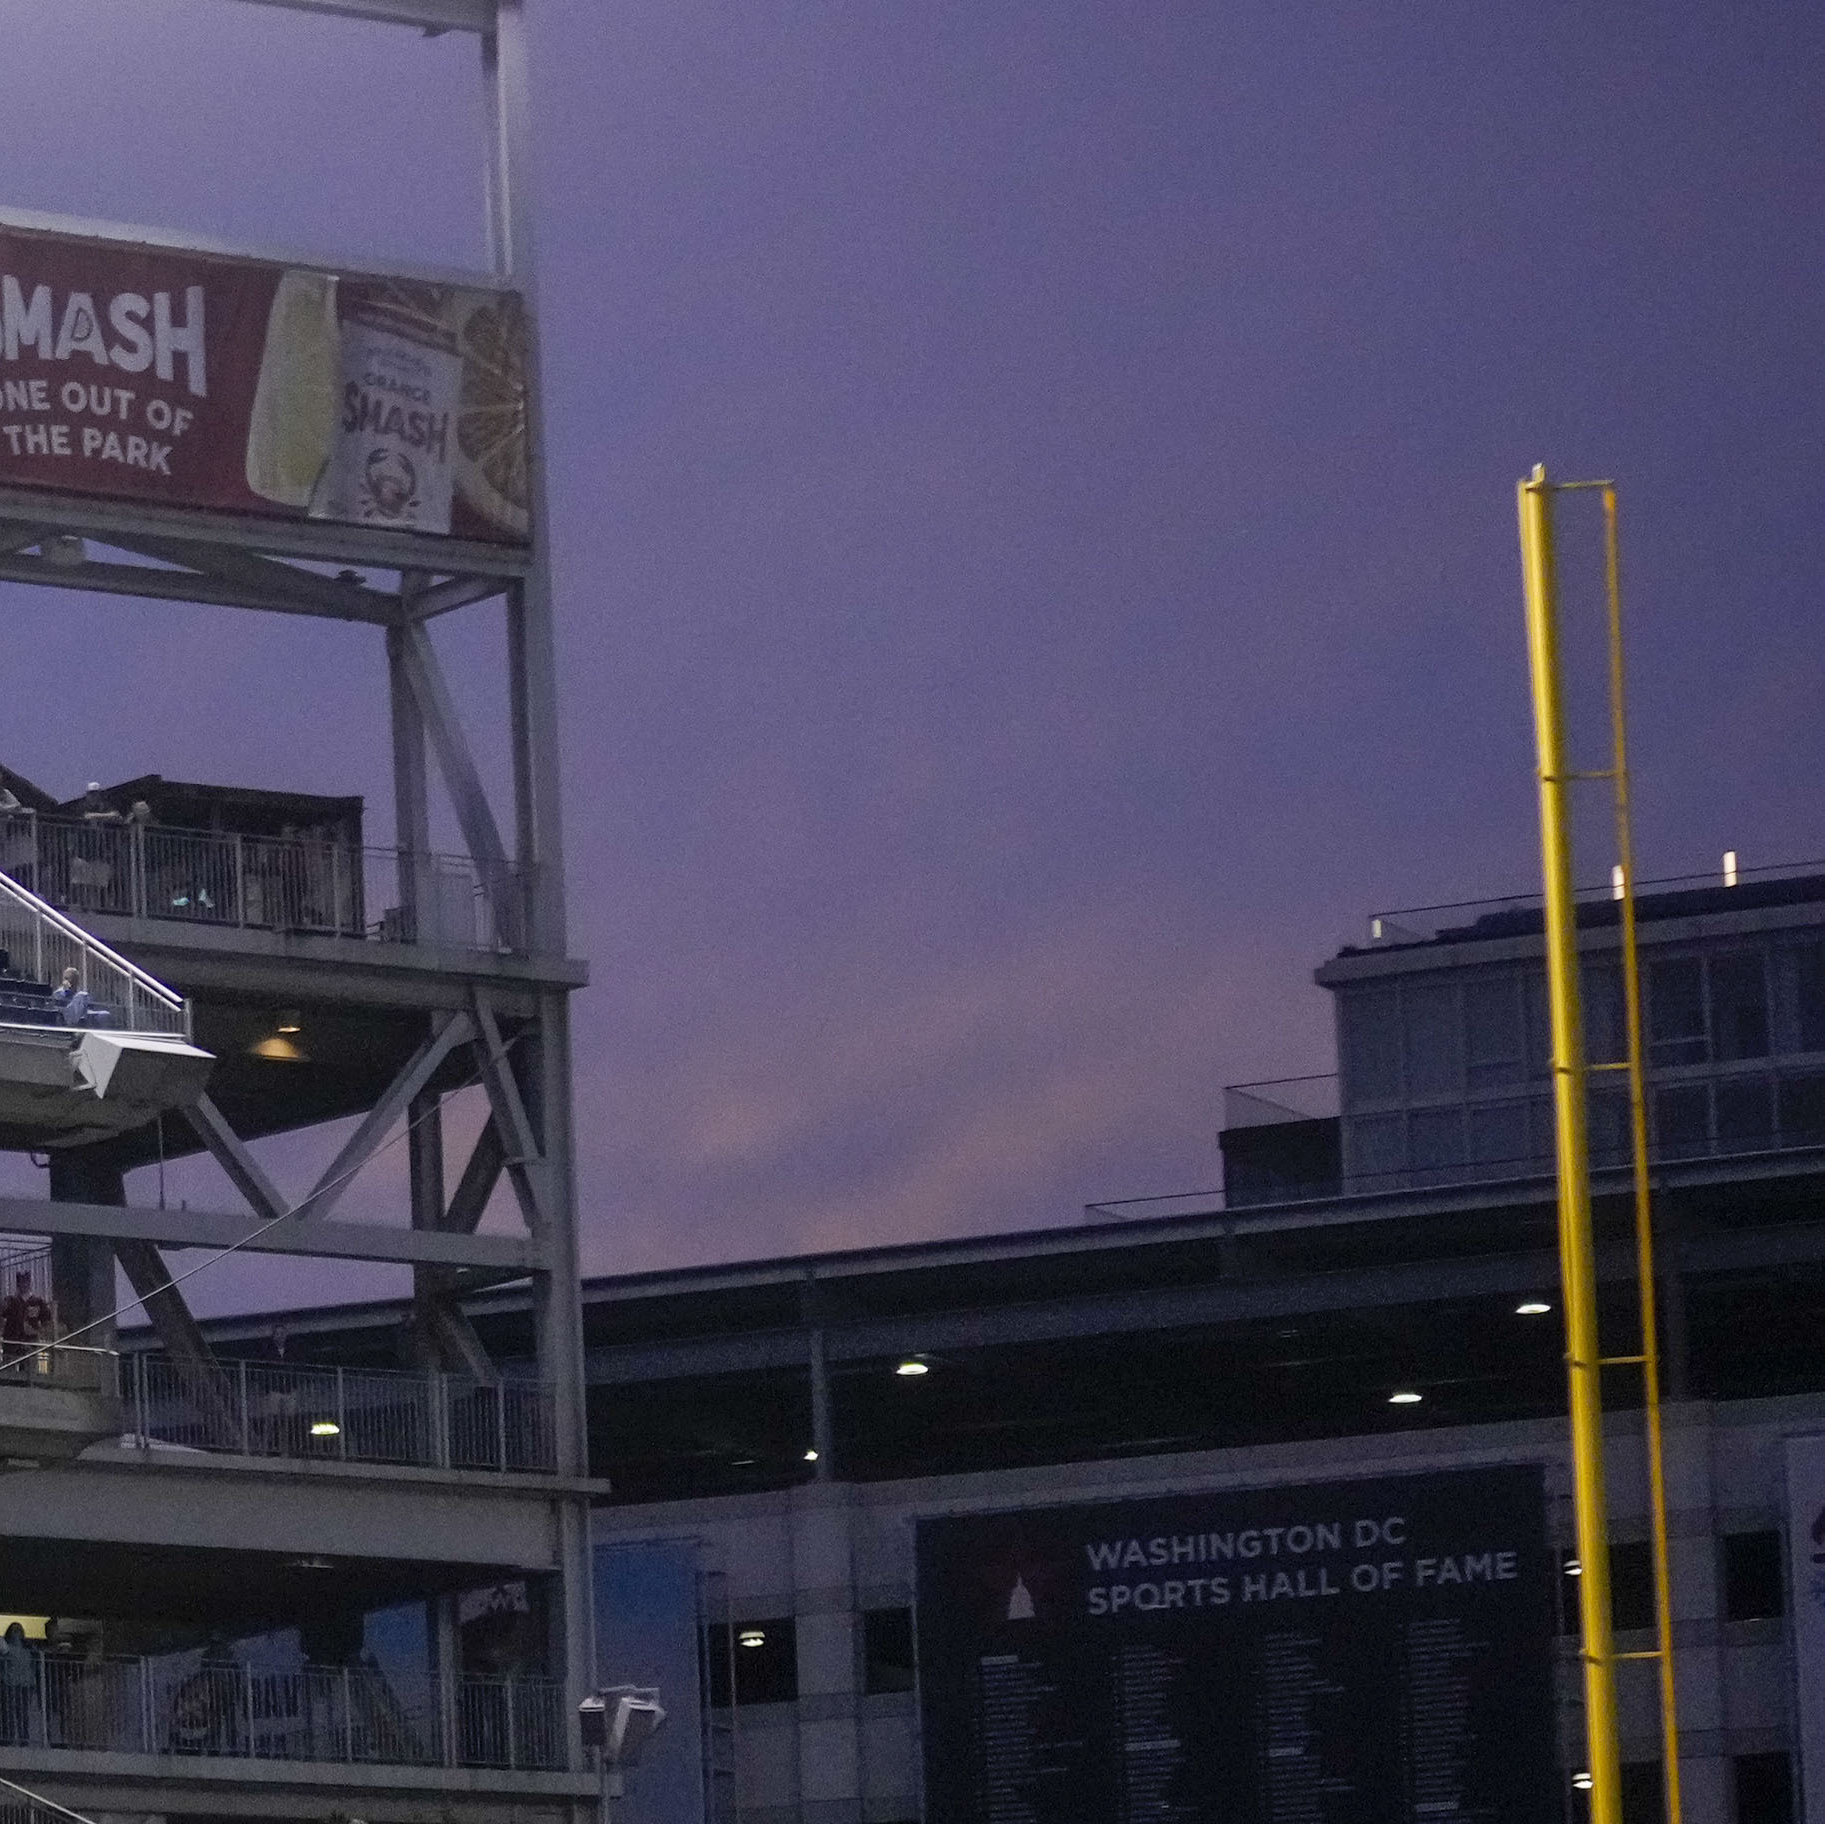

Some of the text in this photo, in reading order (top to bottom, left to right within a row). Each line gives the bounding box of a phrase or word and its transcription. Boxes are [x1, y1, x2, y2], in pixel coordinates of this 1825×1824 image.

[62, 382, 135, 419] OUT
[146, 400, 193, 437] OF
[342, 381, 448, 463] SMASH
[3, 424, 174, 475] THE PARK
[1085, 1517, 1406, 1571] WASHINGTON DC
[1088, 1551, 1518, 1615] SPORTS HALL OF FAME
